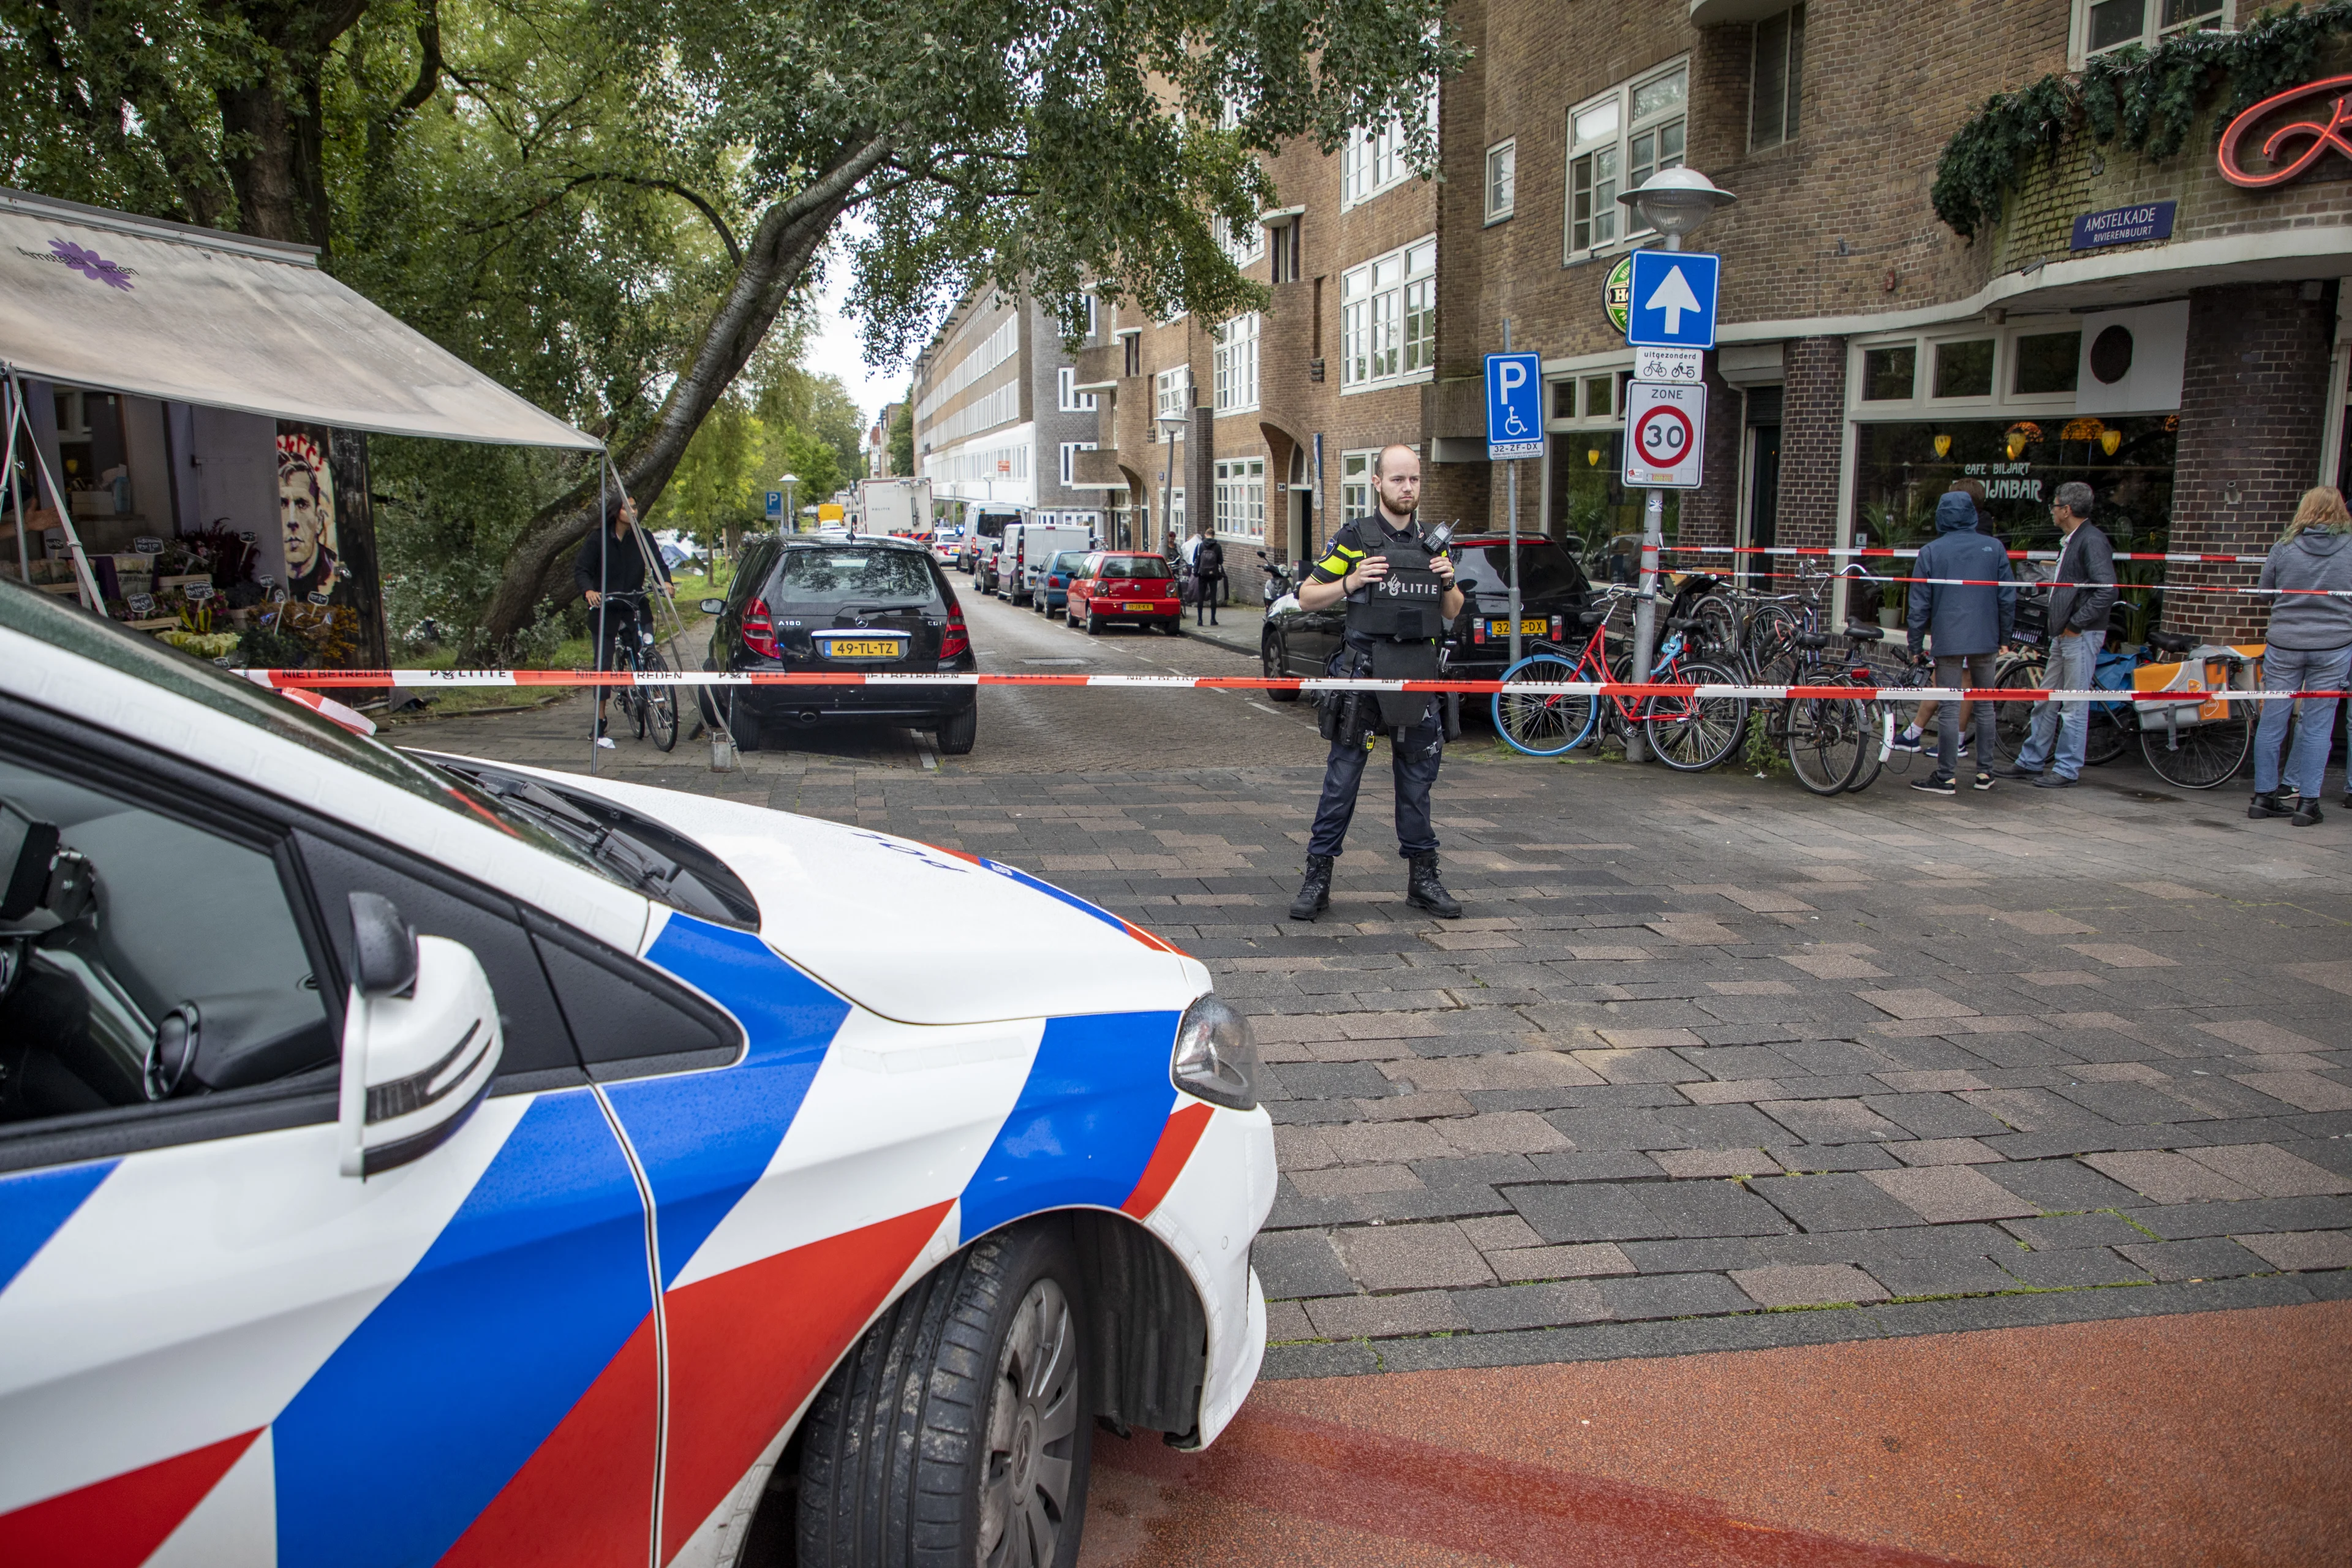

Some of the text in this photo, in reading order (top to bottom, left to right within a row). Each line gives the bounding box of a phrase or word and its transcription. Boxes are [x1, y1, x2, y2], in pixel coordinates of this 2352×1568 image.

[2084, 208, 2156, 232] AMSTELKADE
[2094, 225, 2153, 243] RIVIERENBUURT
[1499, 361, 1526, 405] P
[1651, 389, 1683, 399] ZONE
[1646, 425, 1684, 448] 30
[1494, 443, 1537, 452] 32-ZF-DX
[1965, 462, 2031, 475] CAFE BILJART
[769, 494, 778, 506] P
[1379, 578, 1437, 596] POLITIE
[837, 643, 893, 655] 49-TL-TZ
